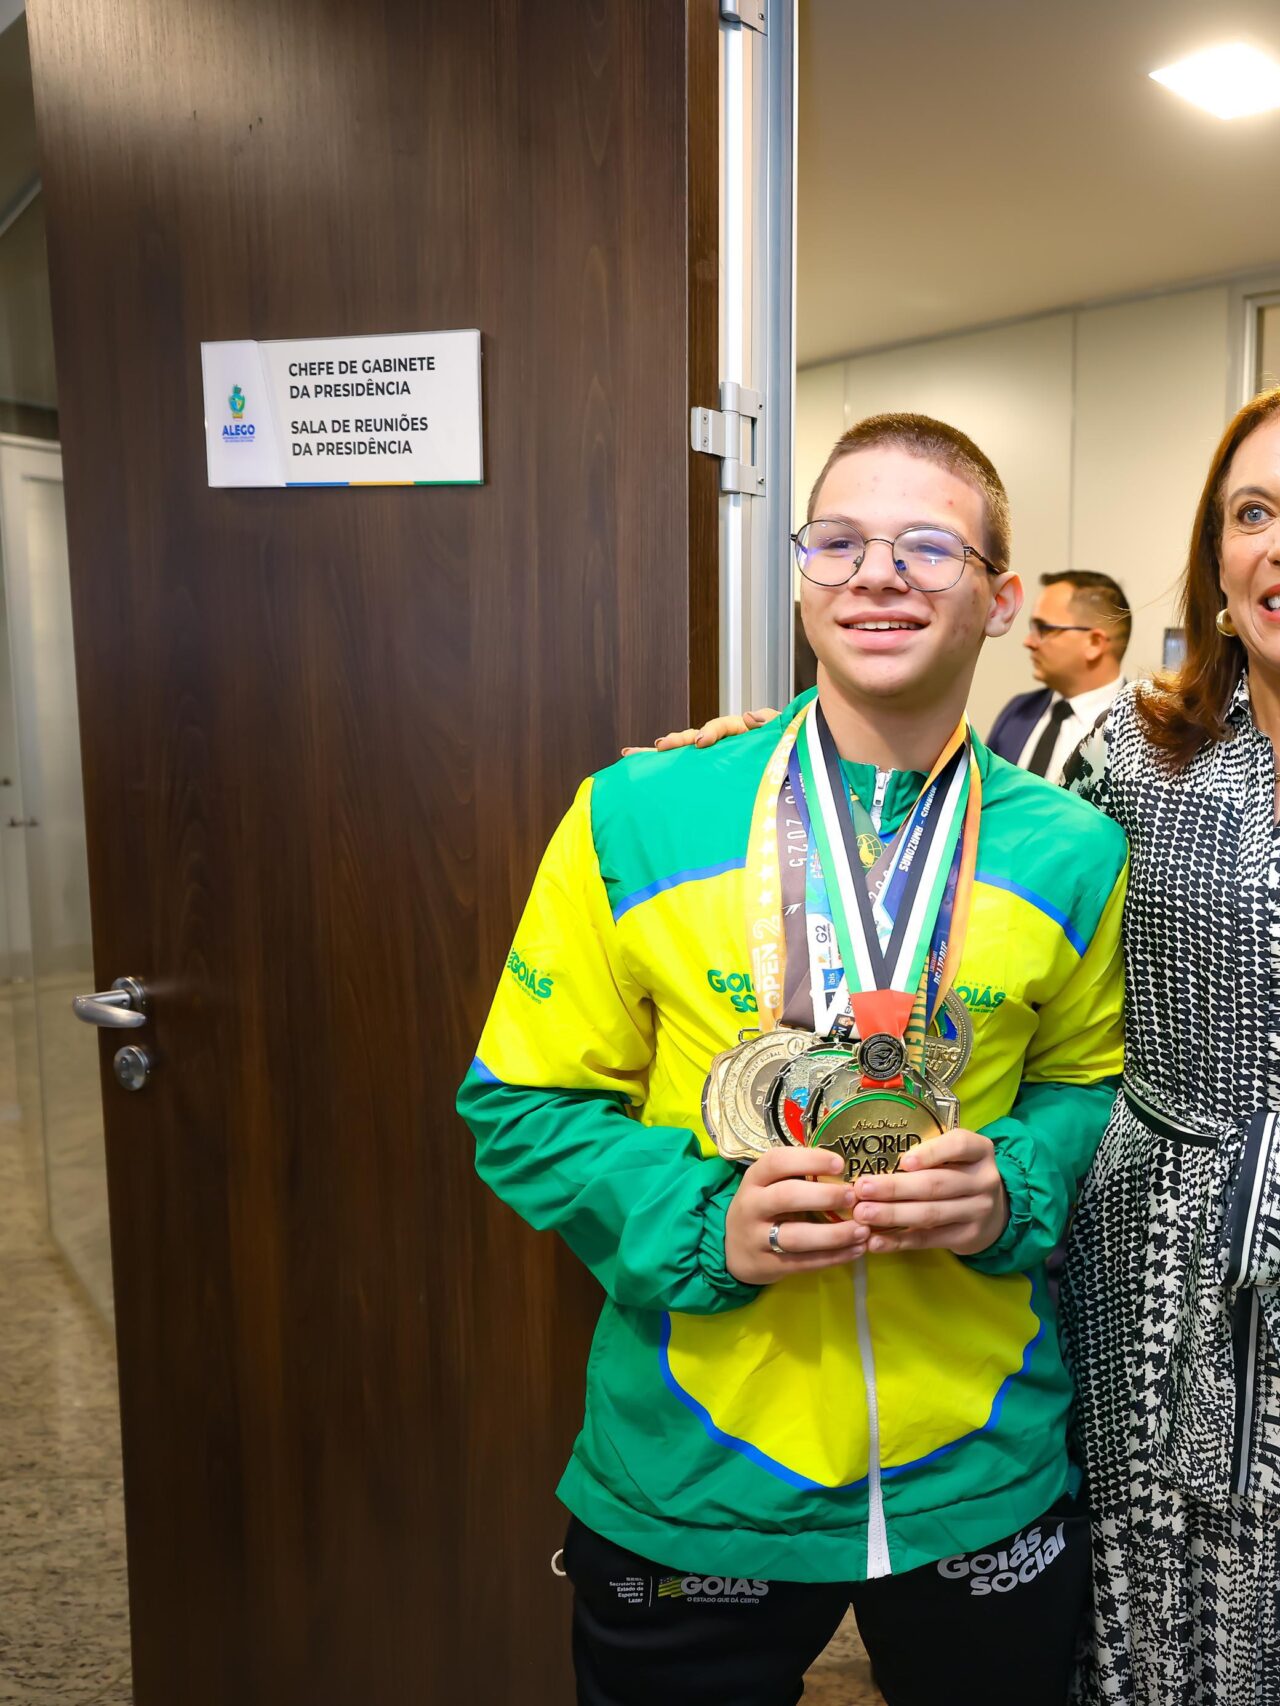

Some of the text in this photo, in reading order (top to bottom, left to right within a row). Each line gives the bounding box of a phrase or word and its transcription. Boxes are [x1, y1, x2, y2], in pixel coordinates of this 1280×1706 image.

[288, 356, 436, 377] CHEFE DE GABINETE
[289, 378, 411, 399] DA PRESIDÊNCIA
[290, 413, 428, 435] SALA DE REUNIÕES
[291, 437, 413, 456] DA PRESIDÊNCIA
[898, 825, 924, 872] AMAZONAS
[815, 924, 828, 943] G2
[510, 952, 554, 998] GOIÁS
[956, 985, 1007, 1008] OIÁS
[839, 1132, 921, 1156] WORLD
